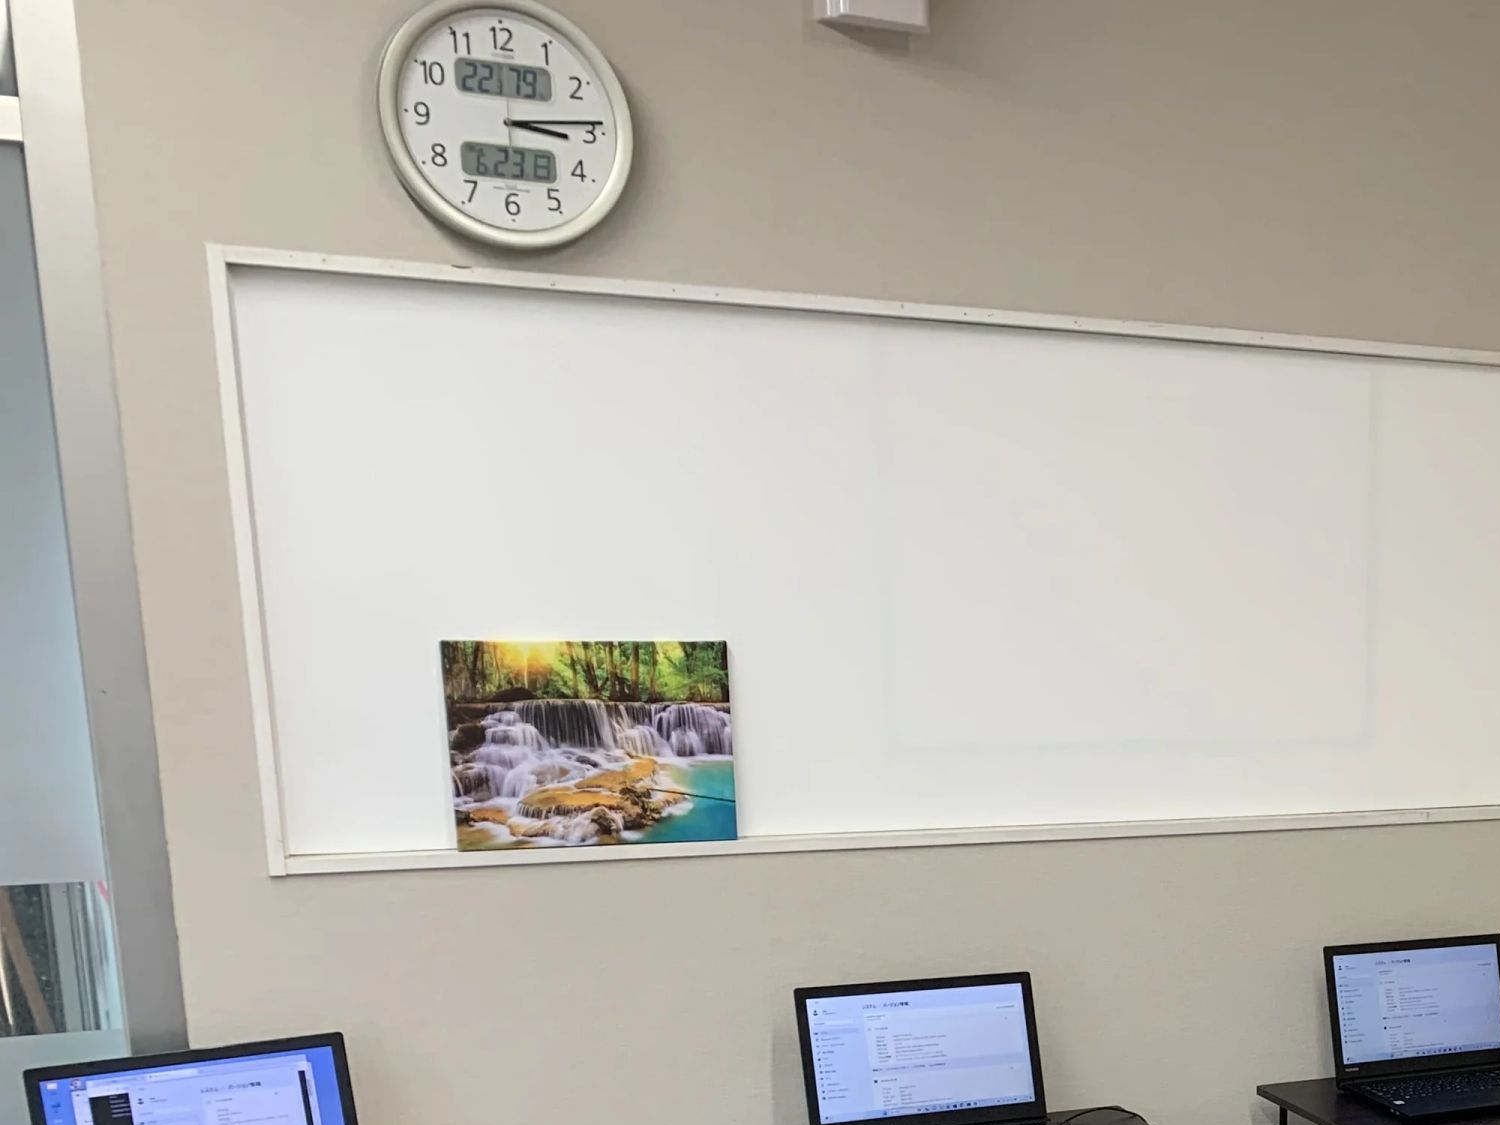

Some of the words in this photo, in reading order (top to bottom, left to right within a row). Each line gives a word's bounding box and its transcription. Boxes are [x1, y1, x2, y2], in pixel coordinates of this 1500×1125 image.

[450, 28, 471, 55] 11
[489, 26, 514, 52] 12
[541, 42, 549, 66] 1
[420, 61, 445, 86] 10
[568, 76, 584, 100] 2
[413, 102, 430, 126] 9
[583, 122, 597, 145] 3
[431, 143, 448, 168] 8
[571, 160, 587, 182] 4
[463, 180, 478, 203] 7
[547, 189, 562, 211] 5
[505, 193, 521, 216] 6
